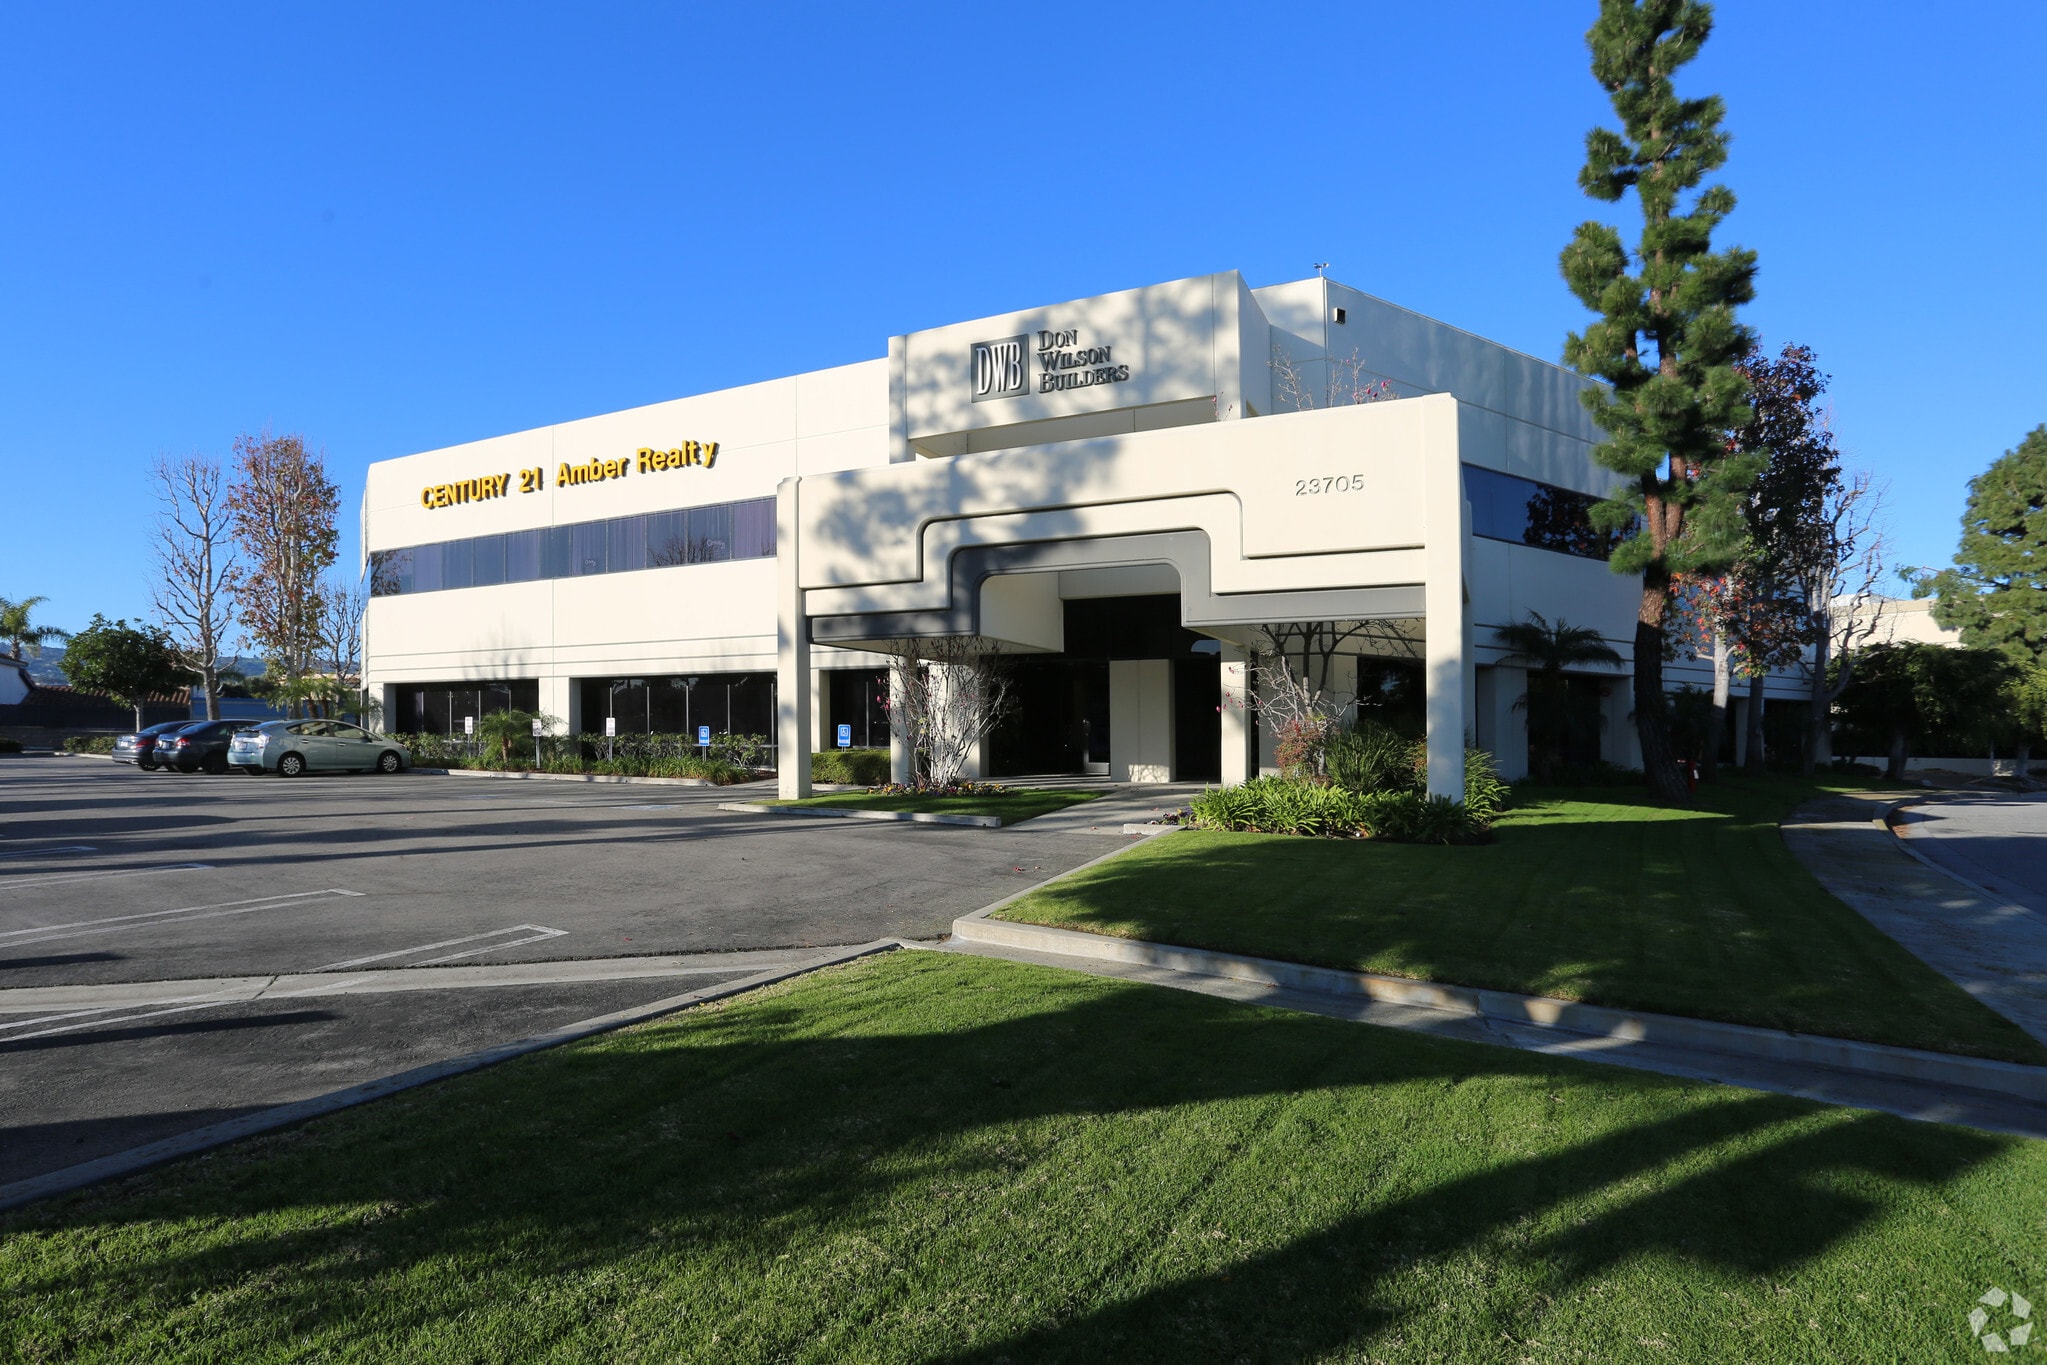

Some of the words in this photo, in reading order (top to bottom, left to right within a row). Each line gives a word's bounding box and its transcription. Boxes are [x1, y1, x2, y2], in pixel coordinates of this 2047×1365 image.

[976, 341, 1023, 395] DWB
[421, 473, 509, 509] CENTURY
[518, 467, 544, 493] 21
[555, 457, 629, 487] Amber
[636, 440, 720, 474] Realty
[1295, 474, 1364, 496] 23705
